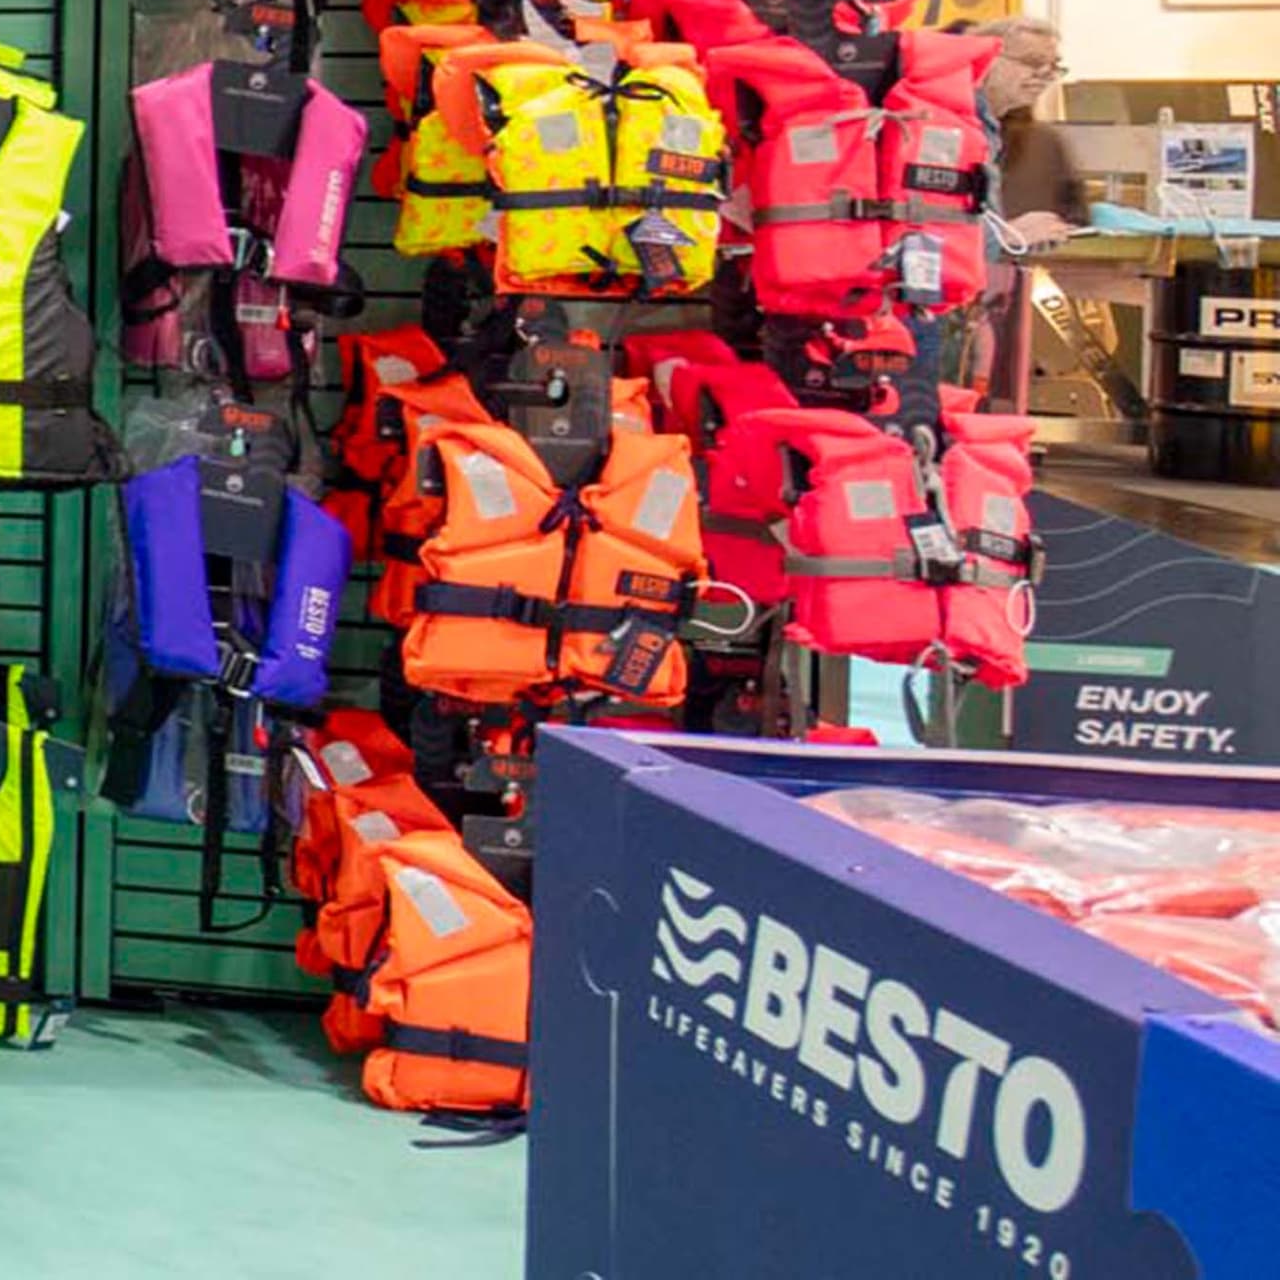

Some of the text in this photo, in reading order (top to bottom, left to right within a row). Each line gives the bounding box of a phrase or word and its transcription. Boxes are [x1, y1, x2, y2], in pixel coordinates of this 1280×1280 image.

[660, 153, 705, 175] BESTO
[915, 168, 959, 190] BESTO
[630, 574, 672, 595] BESTO
[305, 587, 331, 636] BESTO
[1076, 685, 1210, 716] ENJOY
[1074, 718, 1236, 754] SAFETY.
[743, 915, 1086, 1212] BESTO
[647, 996, 1071, 1280] LIFESAVERS SINCE 1920
